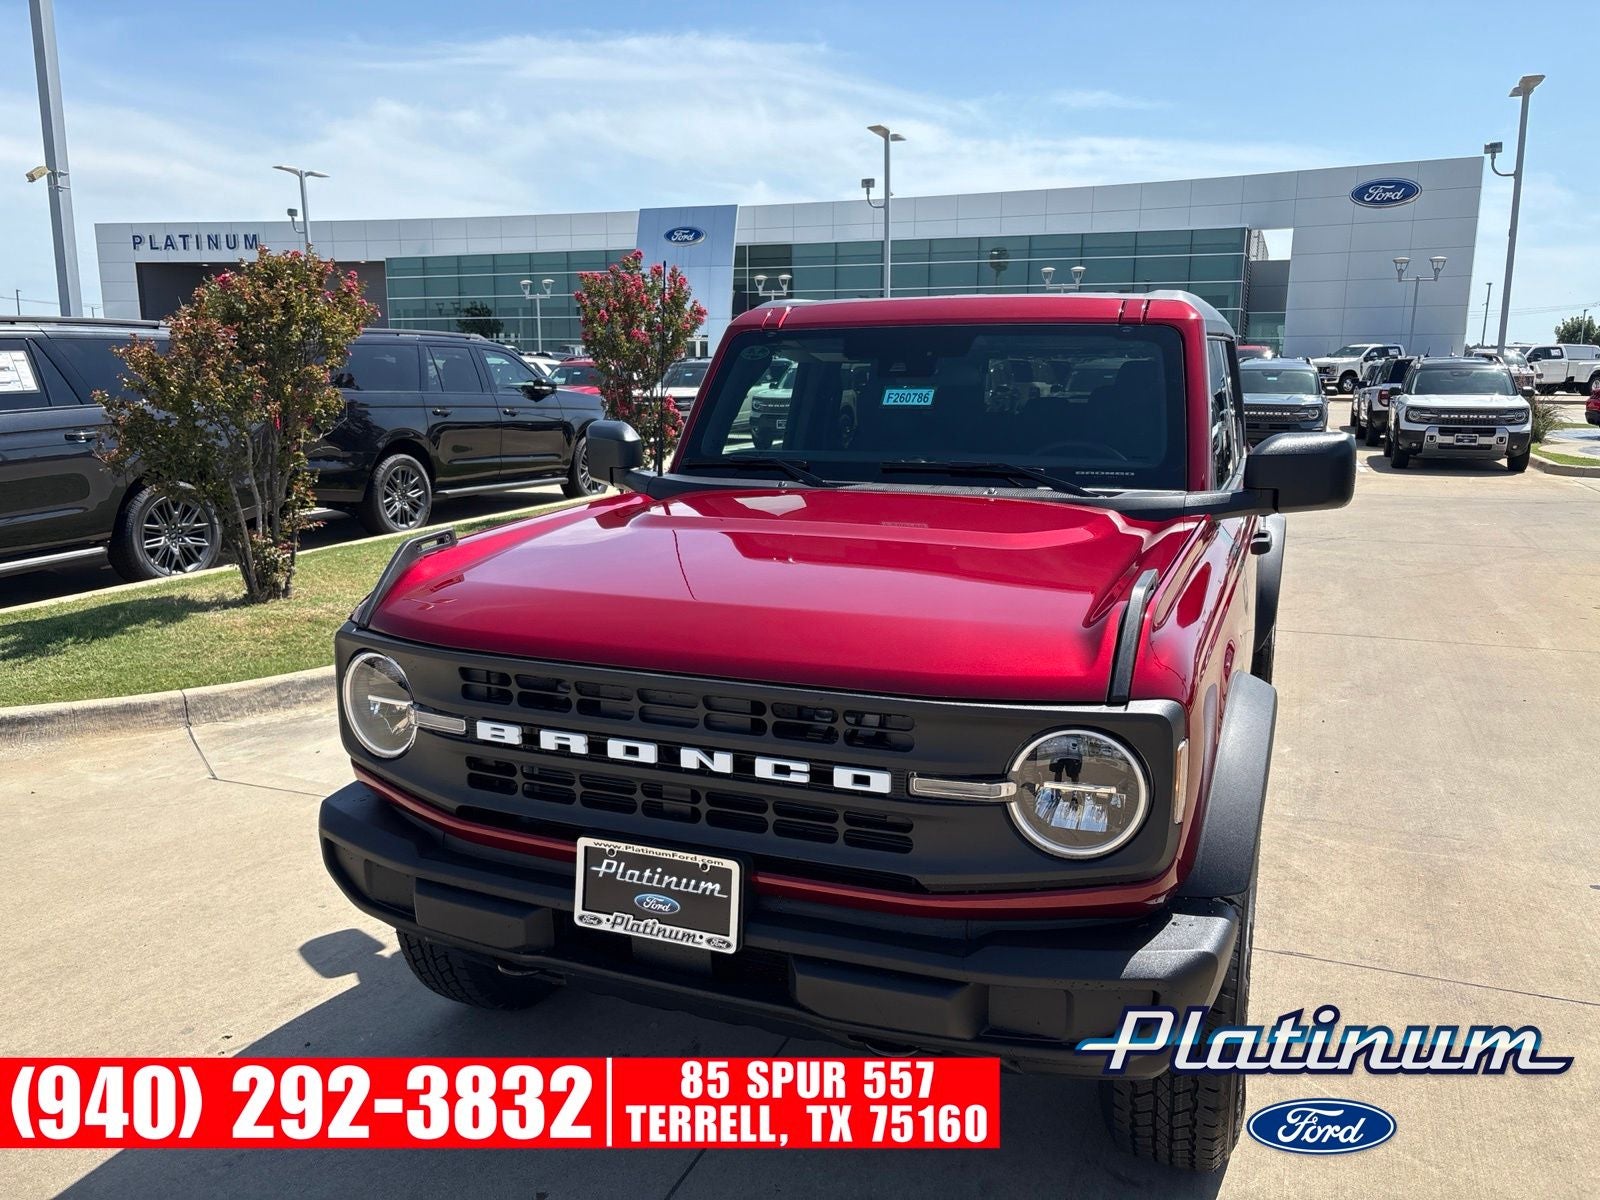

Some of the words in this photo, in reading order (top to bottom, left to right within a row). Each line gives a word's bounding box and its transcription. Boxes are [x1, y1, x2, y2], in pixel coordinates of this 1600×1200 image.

[1364, 184, 1405, 201] Ford
[131, 233, 258, 250] PLATINUM
[671, 229, 695, 241] Ford
[886, 392, 930, 404] F260786
[476, 719, 891, 794] BRONCO
[593, 841, 724, 867] www.PlatinumFord.com
[591, 858, 728, 898] Platinum
[642, 895, 671, 912] Ford
[581, 914, 600, 926] Ford
[611, 913, 703, 945] Platinum
[709, 937, 729, 949] Ford
